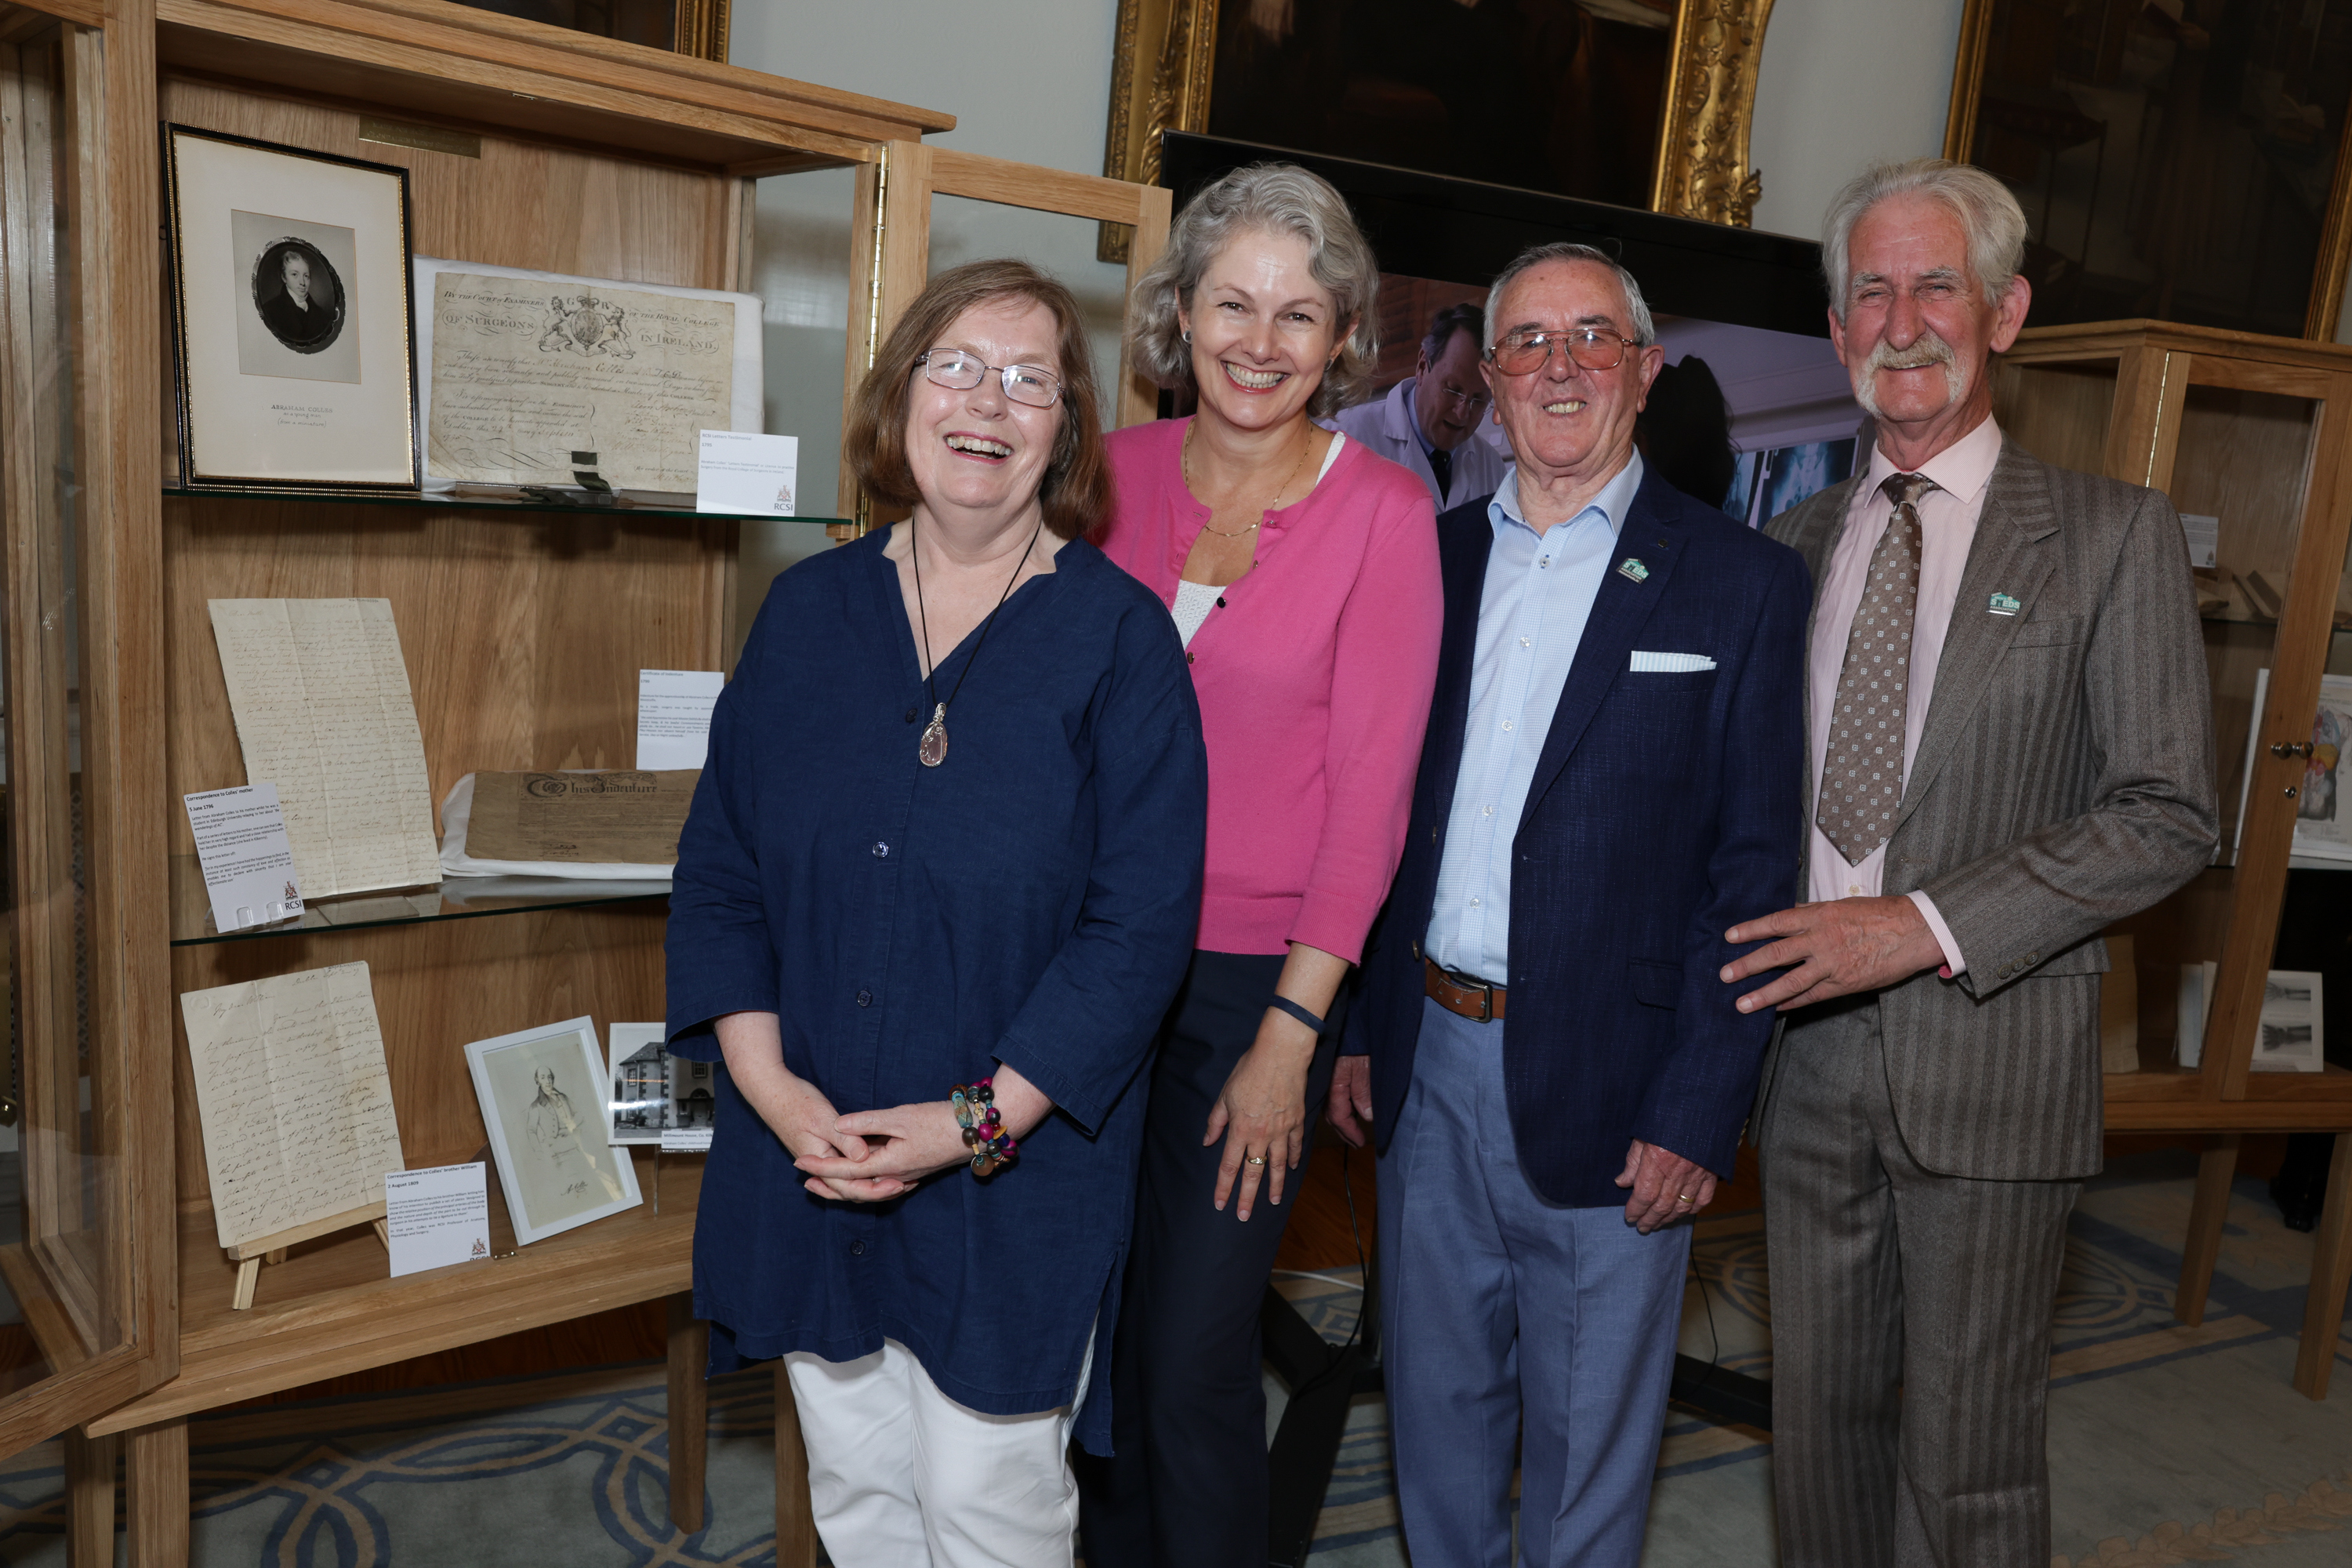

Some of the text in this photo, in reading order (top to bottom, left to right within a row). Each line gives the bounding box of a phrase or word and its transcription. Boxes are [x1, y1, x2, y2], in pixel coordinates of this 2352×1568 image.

[278, 417, 290, 426] (from
[1990, 598, 2021, 609] SHEDS
[285, 900, 302, 910] RCSI
